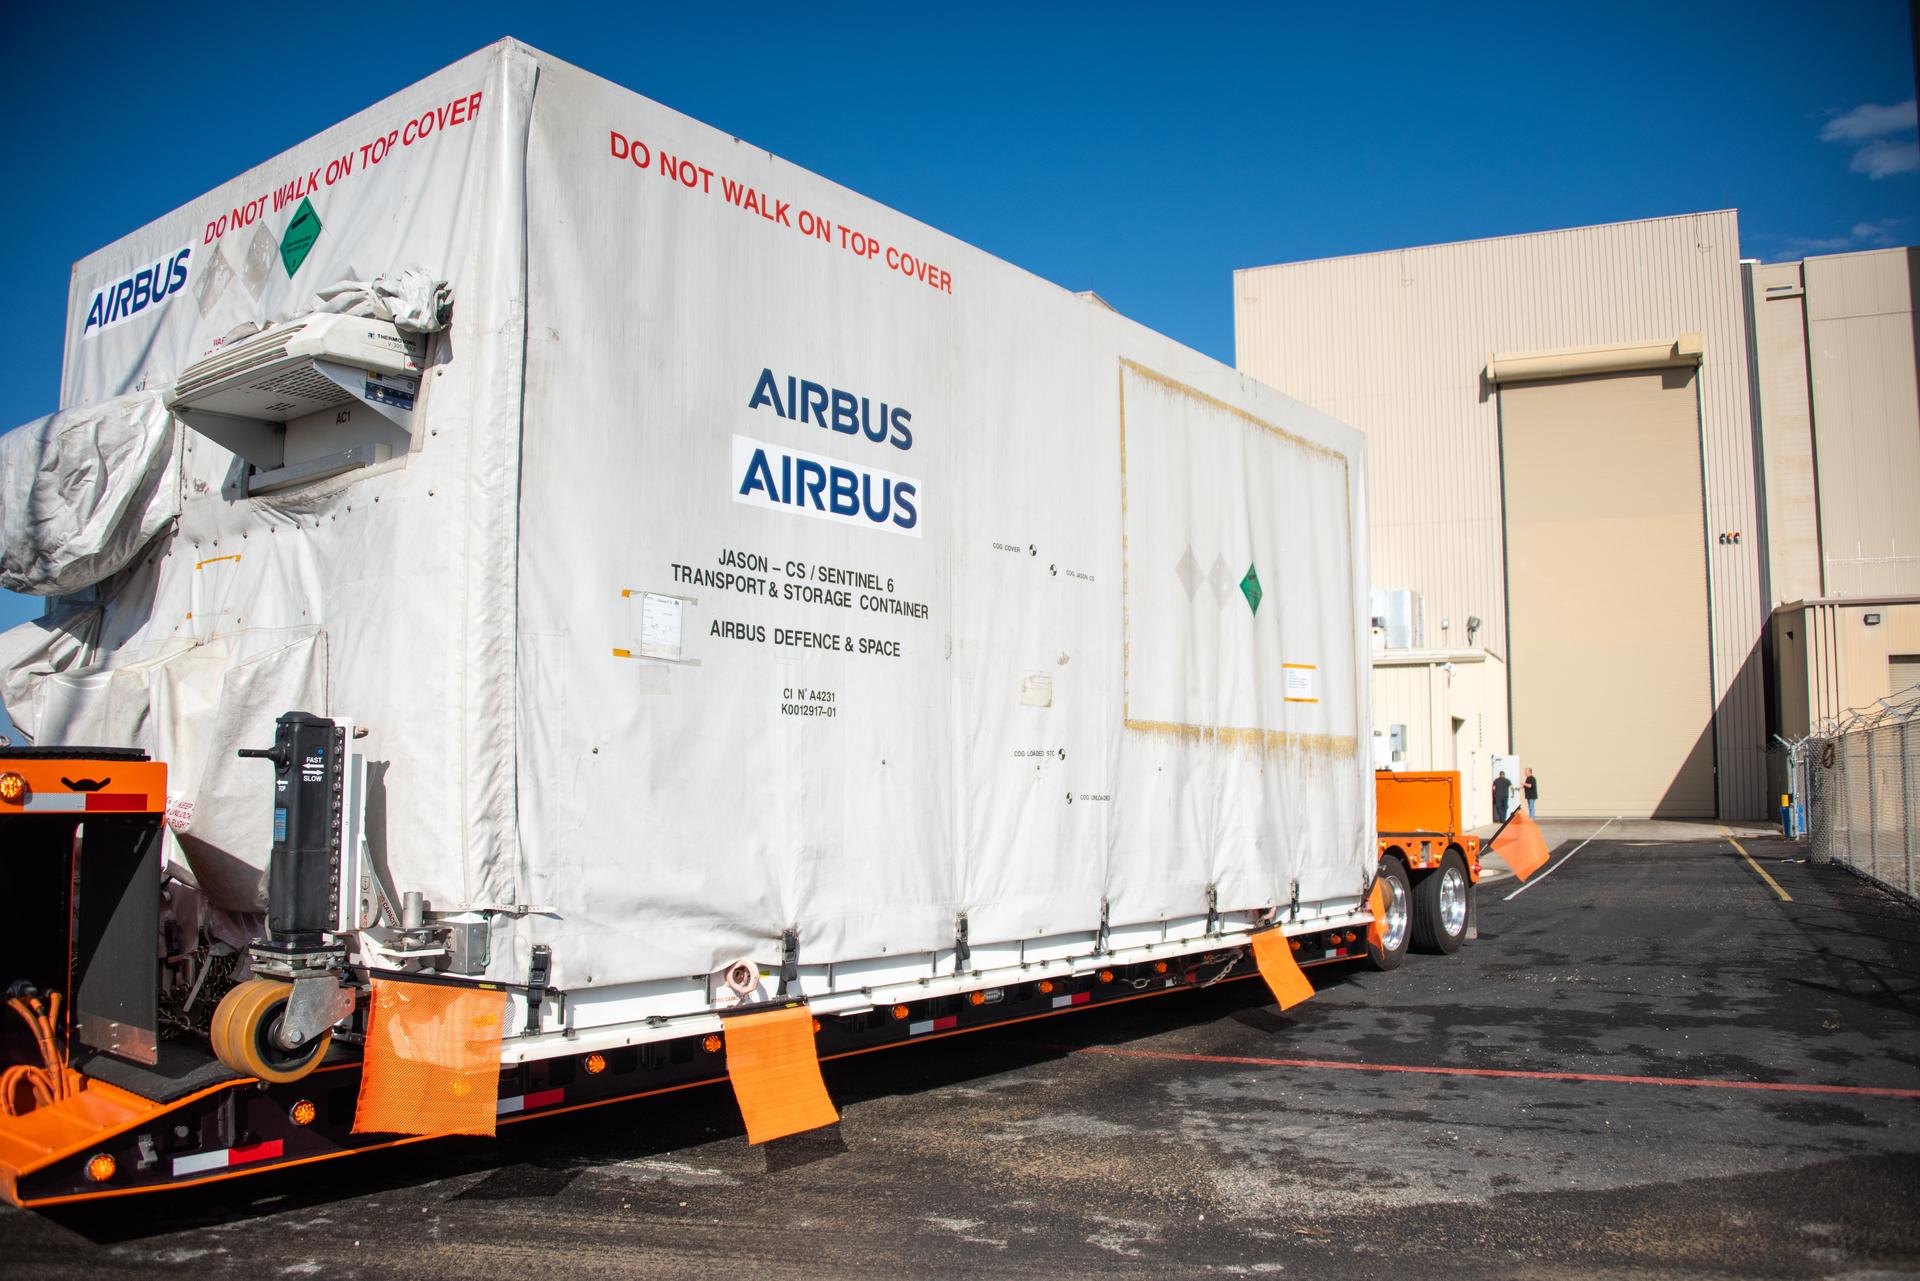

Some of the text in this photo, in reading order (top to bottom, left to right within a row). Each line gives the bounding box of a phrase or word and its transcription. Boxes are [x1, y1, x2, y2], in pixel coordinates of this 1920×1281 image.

[204, 91, 483, 245] DO NOT WALK ON TOP COVER
[610, 131, 952, 294] DO NOT WALK ON TOP COVER
[83, 248, 191, 335] AIRBUS
[335, 410, 351, 425] AC1
[748, 367, 913, 451] AIRBUS
[738, 448, 918, 529] AIRBUS
[719, 548, 768, 573] JASON
[785, 561, 806, 579] CS
[811, 565, 816, 581] /
[818, 566, 884, 592] SENTINEL
[887, 578, 894, 593] 6
[1004, 544, 1021, 553] COVER
[671, 564, 929, 620] TRANSPORT & STORAGE CONTAINER
[710, 619, 901, 657] AIRBUS DEFENCE & SPACE
[781, 703, 837, 717] K0012917-01
[783, 688, 793, 700] CI
[809, 689, 836, 702] A4231
[306, 756, 323, 764] FAST
